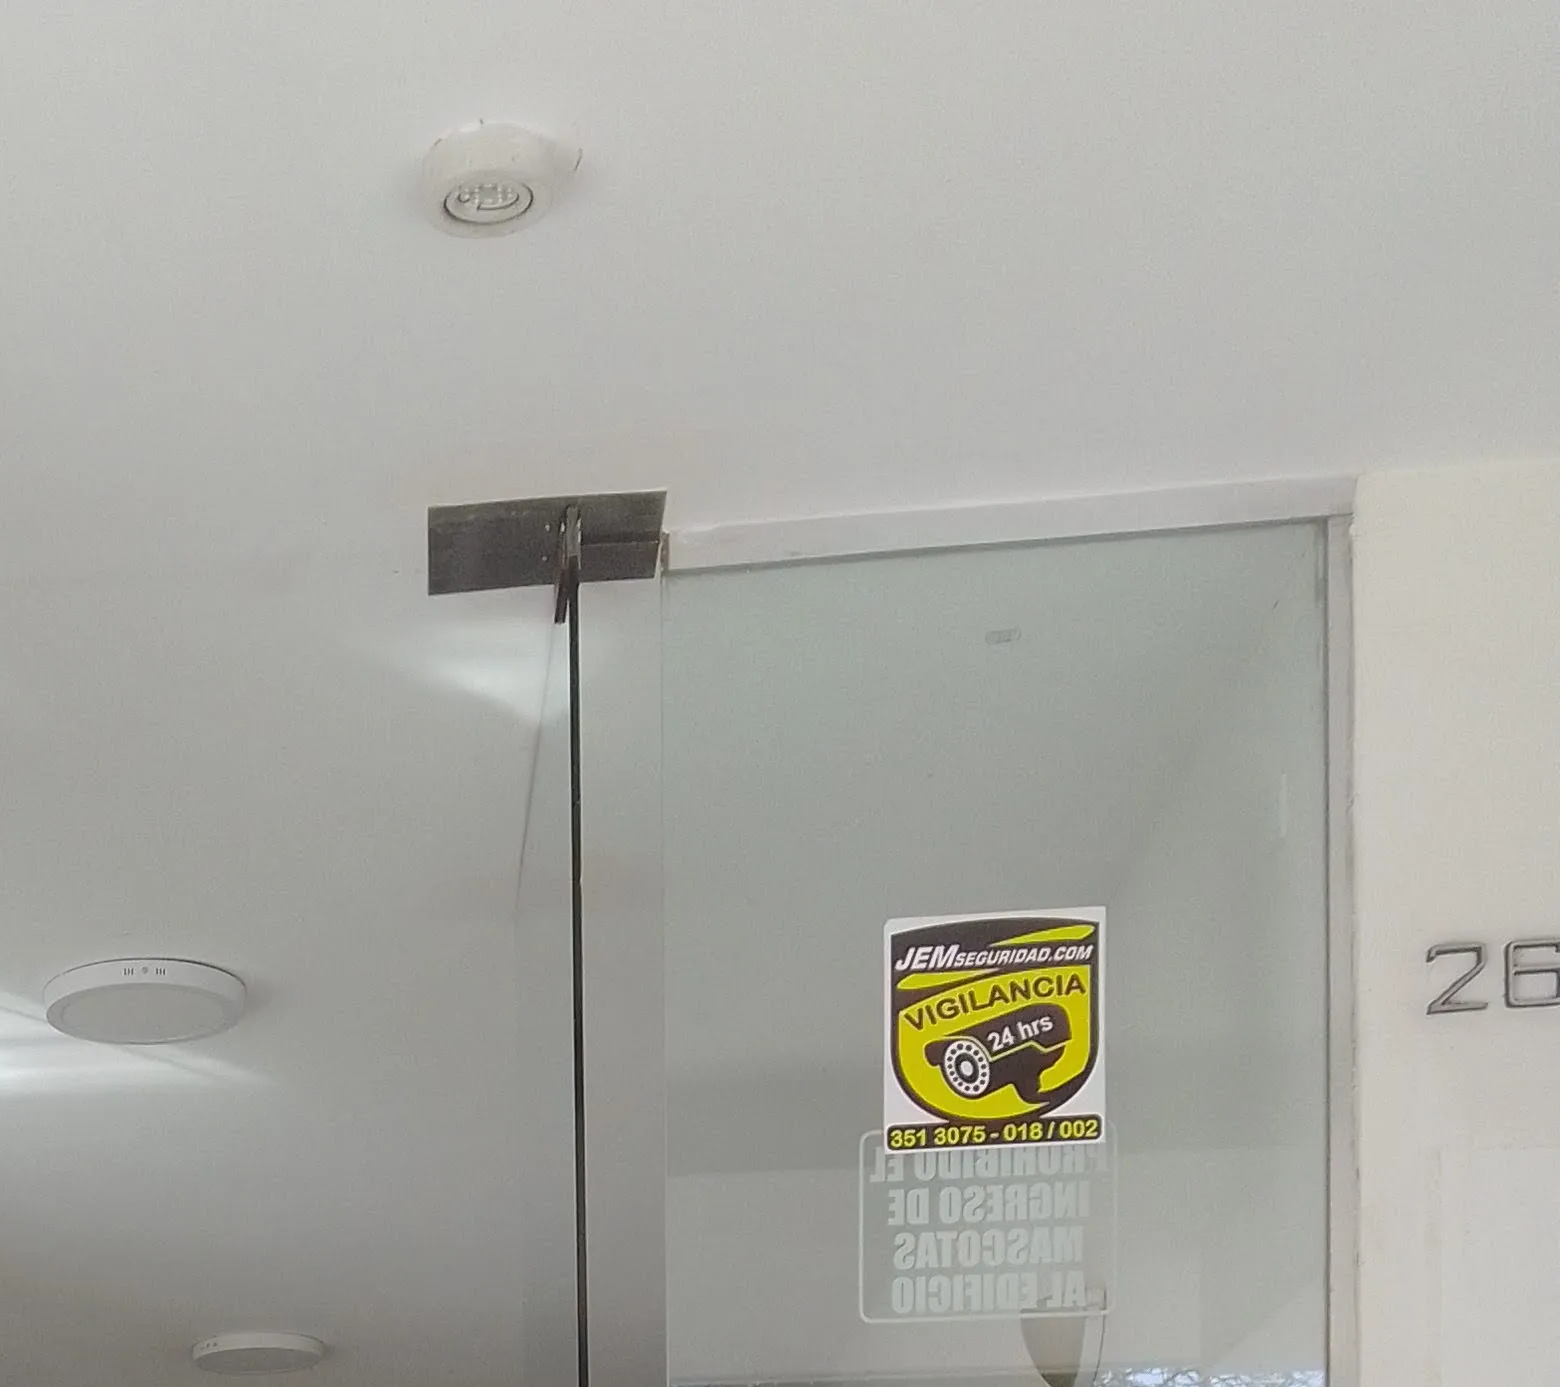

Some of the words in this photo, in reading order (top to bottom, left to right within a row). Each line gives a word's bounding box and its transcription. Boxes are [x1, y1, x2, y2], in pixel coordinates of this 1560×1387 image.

[1426, 937, 1560, 1015] 26
[904, 973, 1086, 1031] VIGILANCIA
[987, 1026, 1015, 1052] 24
[1016, 1016, 1054, 1040] hrs
[890, 1129, 927, 1148] 351
[934, 1125, 986, 1146] 3075
[1003, 1122, 1042, 1141] 018
[1059, 1119, 1099, 1138] 002
